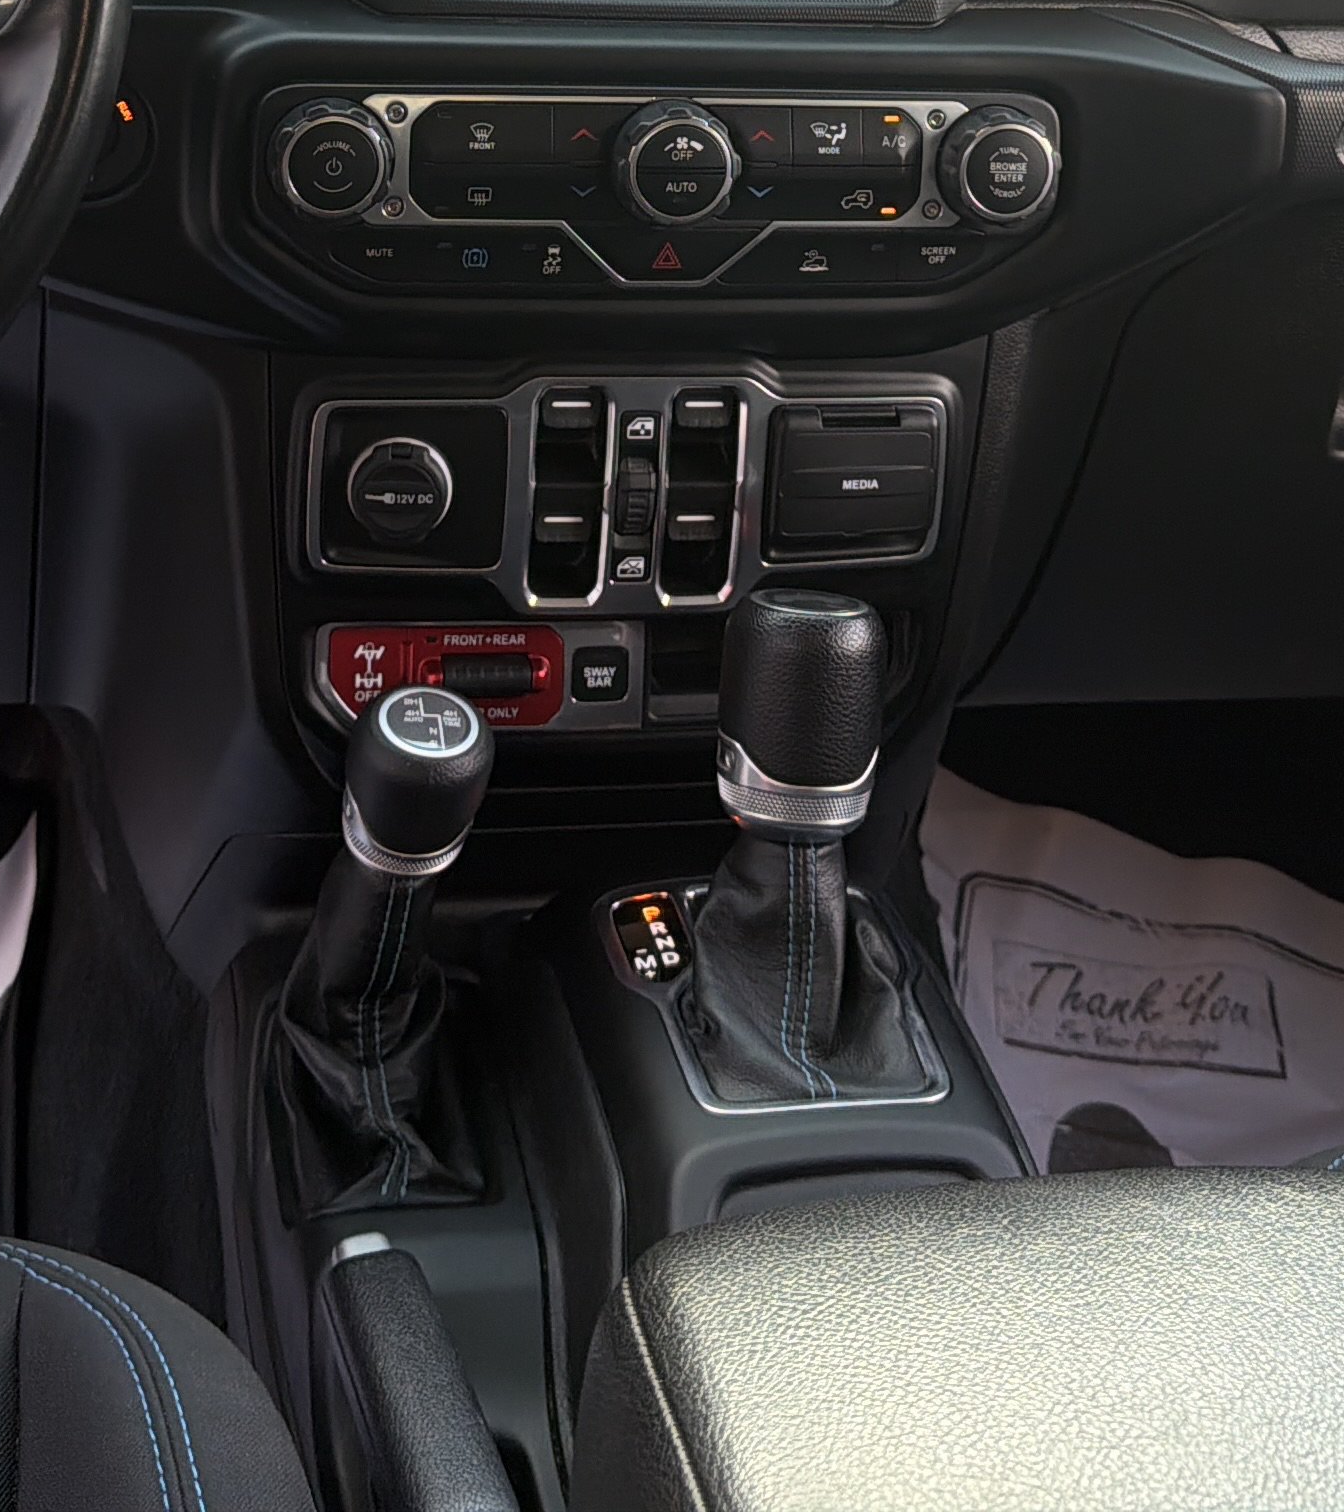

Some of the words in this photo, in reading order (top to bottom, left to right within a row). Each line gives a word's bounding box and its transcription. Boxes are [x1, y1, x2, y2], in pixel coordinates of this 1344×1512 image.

[317, 140, 351, 153] VOLUME
[469, 142, 495, 151] FRONT
[818, 147, 840, 155] MODE
[1000, 147, 1019, 155] TUNE
[671, 151, 693, 162] OFF
[990, 162, 1027, 171] BROWSE
[994, 174, 1023, 183] ENTER
[666, 182, 697, 193] AUTO
[993, 187, 1022, 198] SCROLL
[366, 248, 394, 258] MUTE
[921, 246, 956, 256] SCREEN
[928, 255, 946, 264] OFF
[543, 265, 561, 275] OFF
[842, 479, 879, 491] MEDIA
[395, 493, 415, 504] 12V
[417, 493, 434, 505] DC
[583, 666, 617, 677] SWAY
[587, 676, 612, 687] BAR
[487, 706, 520, 720] ONLY
[650, 922, 668, 936] R
[655, 936, 675, 951] N
[634, 954, 657, 970] M
[661, 951, 680, 967] D
[1028, 962, 1165, 1024] Thank
[1176, 970, 1250, 1026] You
